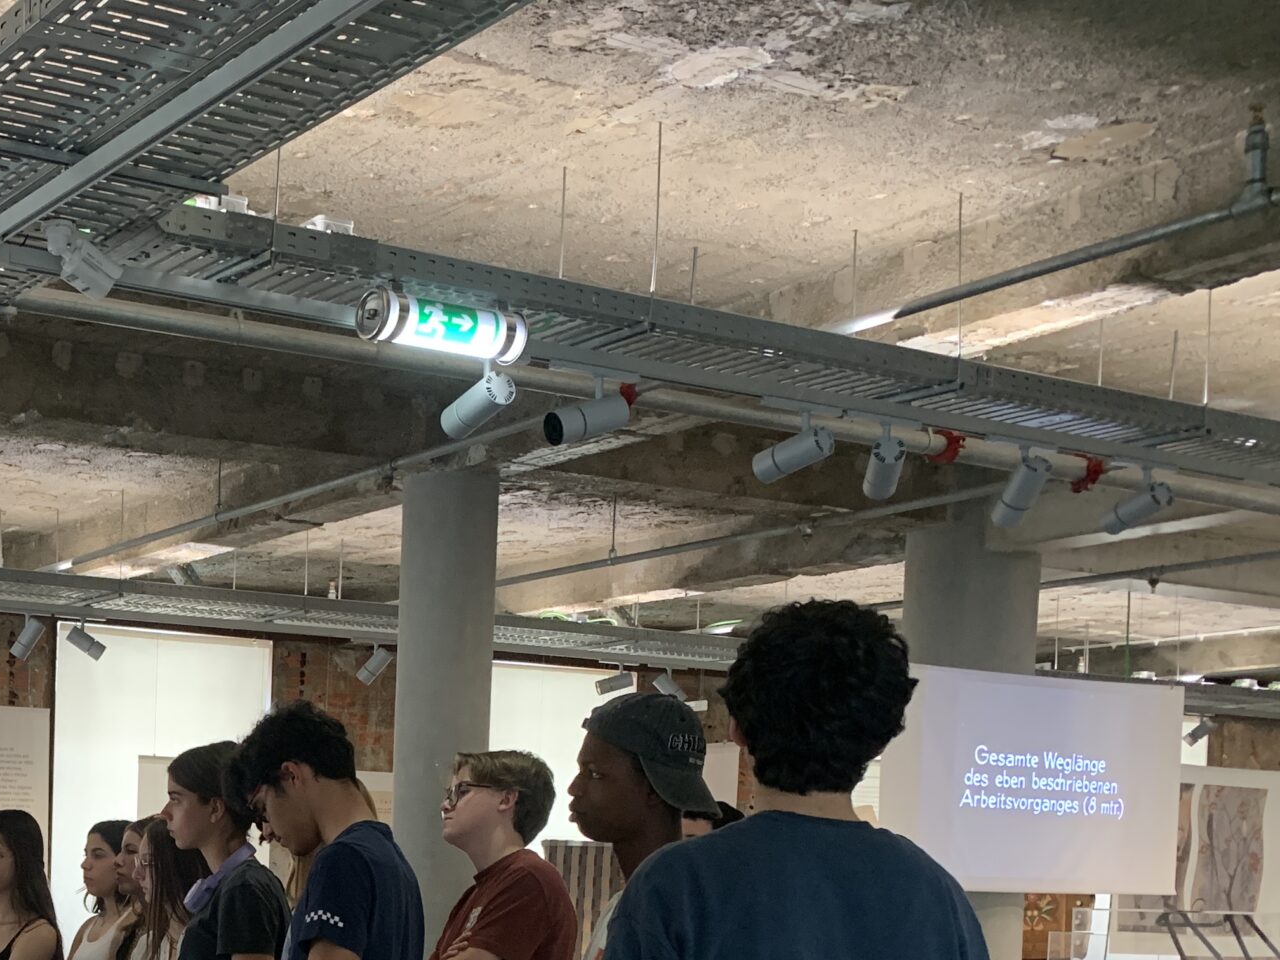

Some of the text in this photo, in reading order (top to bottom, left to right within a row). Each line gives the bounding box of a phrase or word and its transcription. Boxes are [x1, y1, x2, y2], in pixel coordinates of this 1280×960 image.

[667, 733, 705, 753] CHI
[974, 744, 1106, 776] Gesamte Weglänge
[964, 768, 1118, 795] des eben beschriebenen
[959, 788, 1079, 816] Arbeitsvorganges
[1082, 796, 1097, 816] (8
